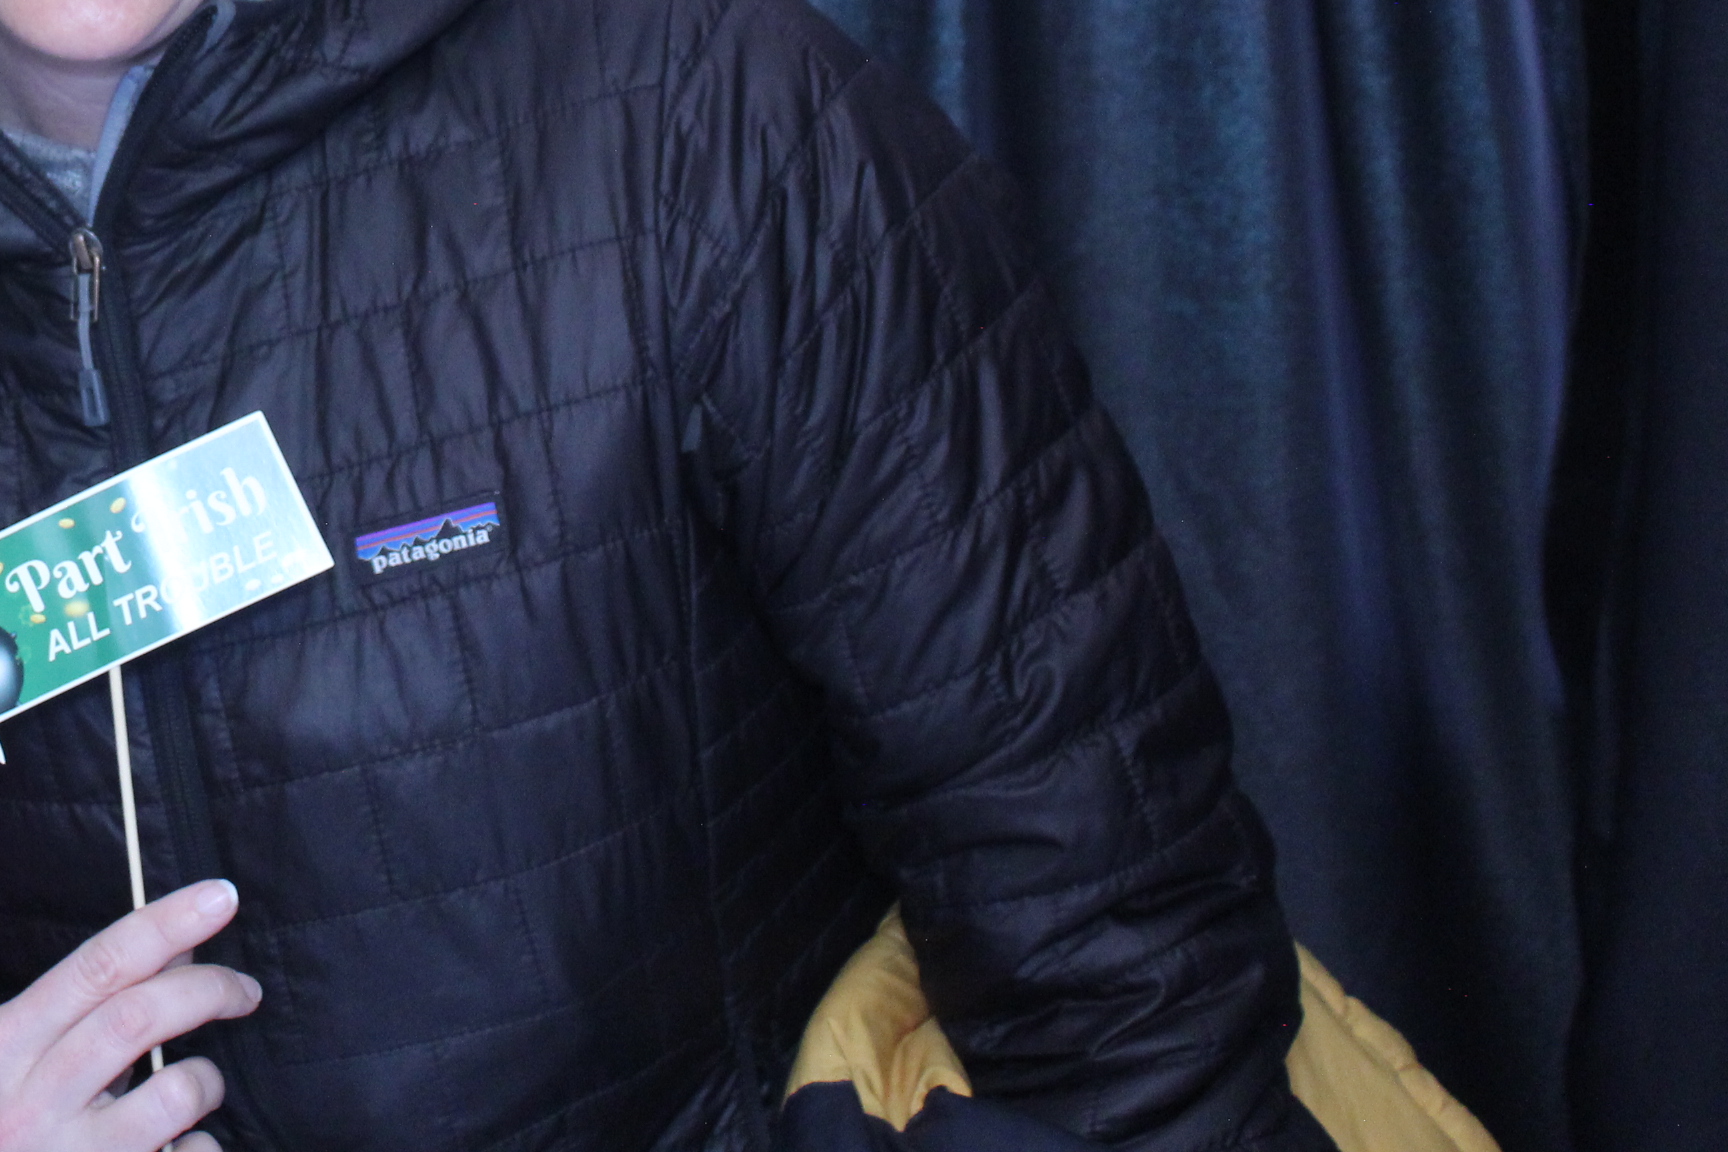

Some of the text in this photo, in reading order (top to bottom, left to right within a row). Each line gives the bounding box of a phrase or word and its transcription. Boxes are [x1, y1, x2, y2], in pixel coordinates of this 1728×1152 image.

[4, 467, 268, 613] Part rish
[372, 528, 491, 574] patagonia
[47, 611, 111, 662] ALL
